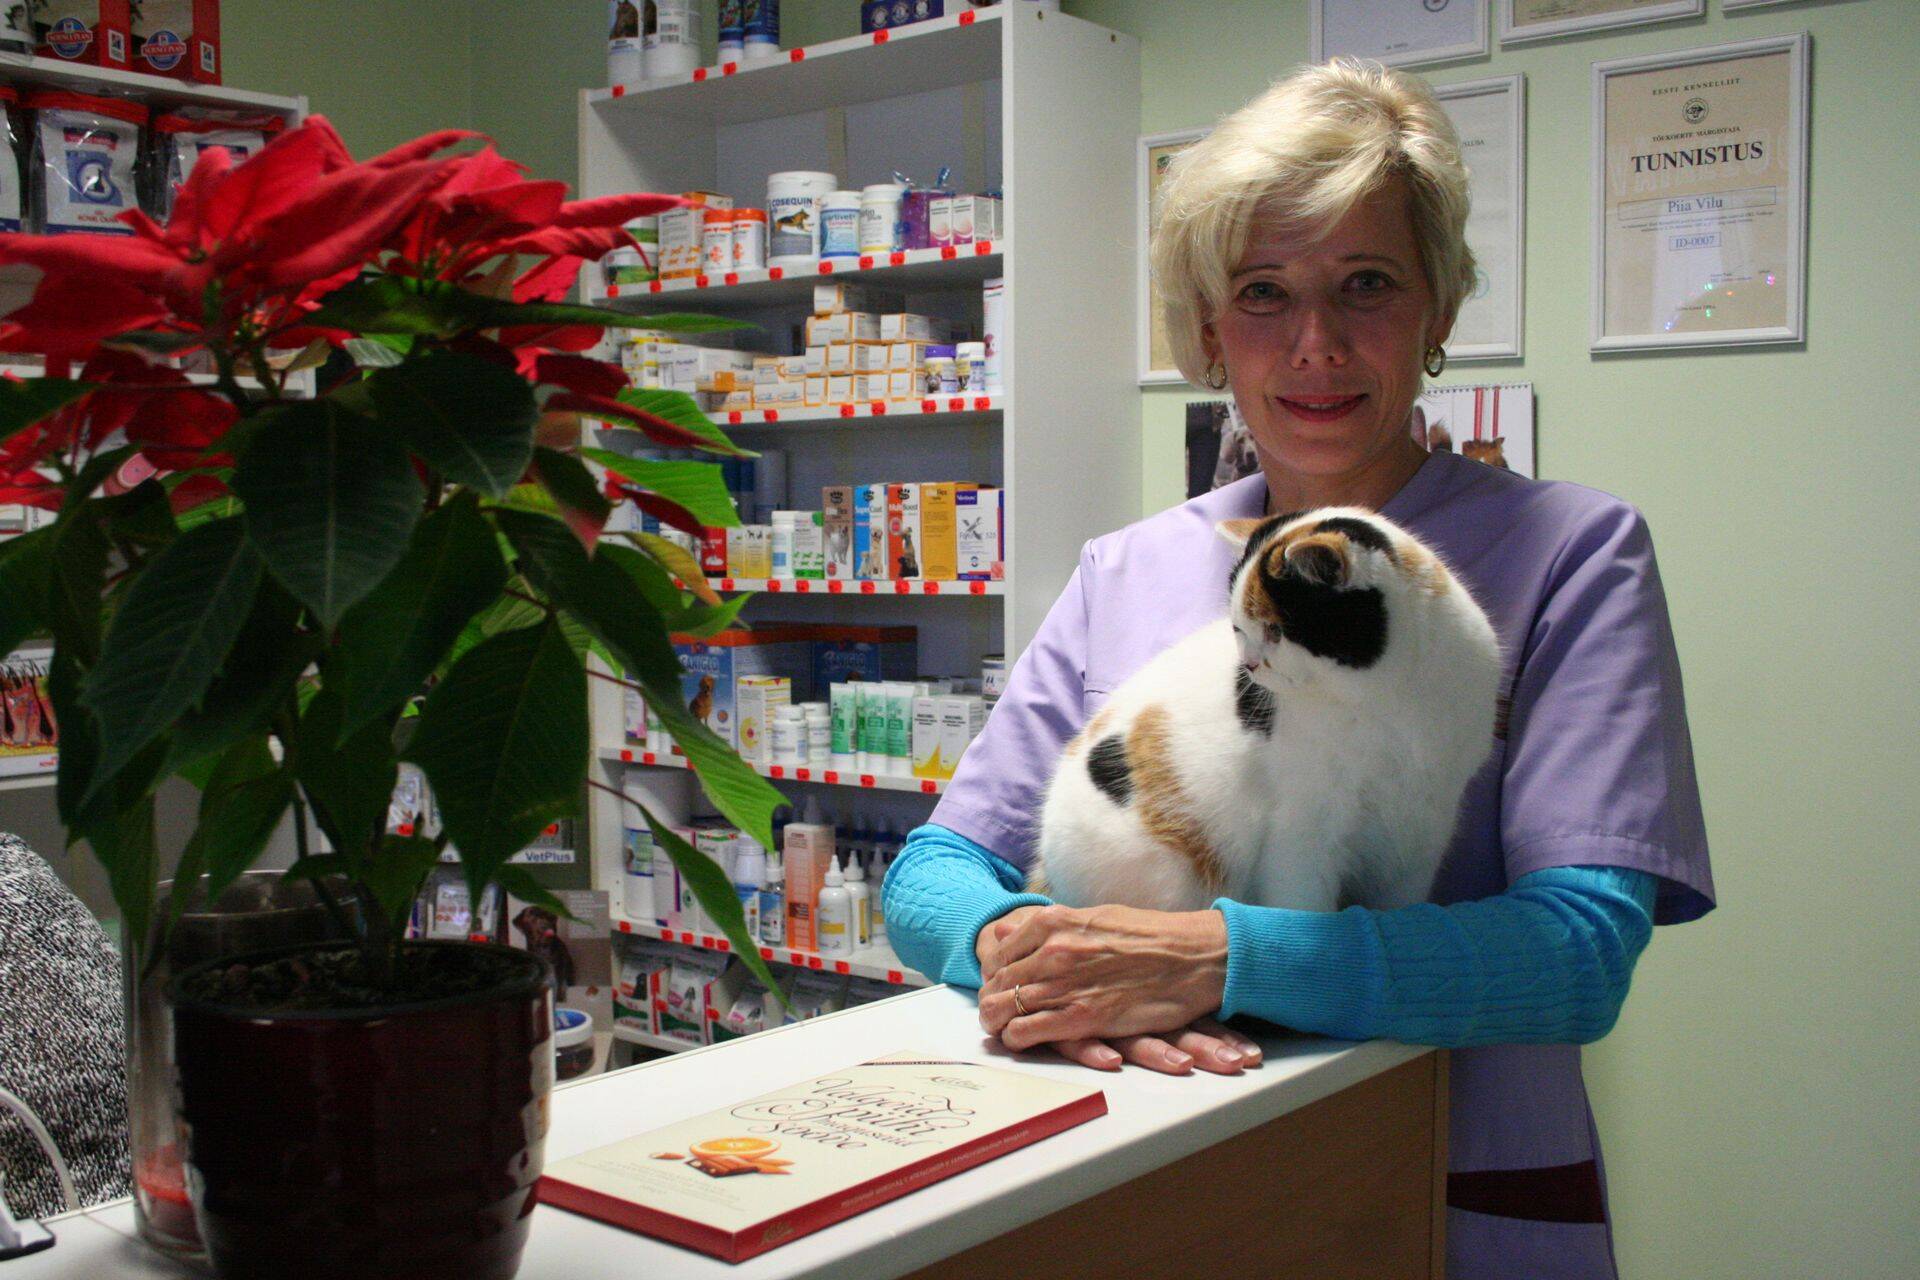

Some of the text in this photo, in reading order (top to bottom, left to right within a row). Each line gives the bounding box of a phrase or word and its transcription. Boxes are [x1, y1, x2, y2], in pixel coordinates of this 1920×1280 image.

[1652, 78, 1740, 95] EESTI KENNELLIIT
[1631, 141, 1763, 173] TUNNISTUS
[772, 197, 813, 207] COSEQUIN
[1668, 197, 1723, 213] Piia Vilu
[1675, 235, 1716, 248] ID-0007
[525, 851, 571, 861] VetPlus
